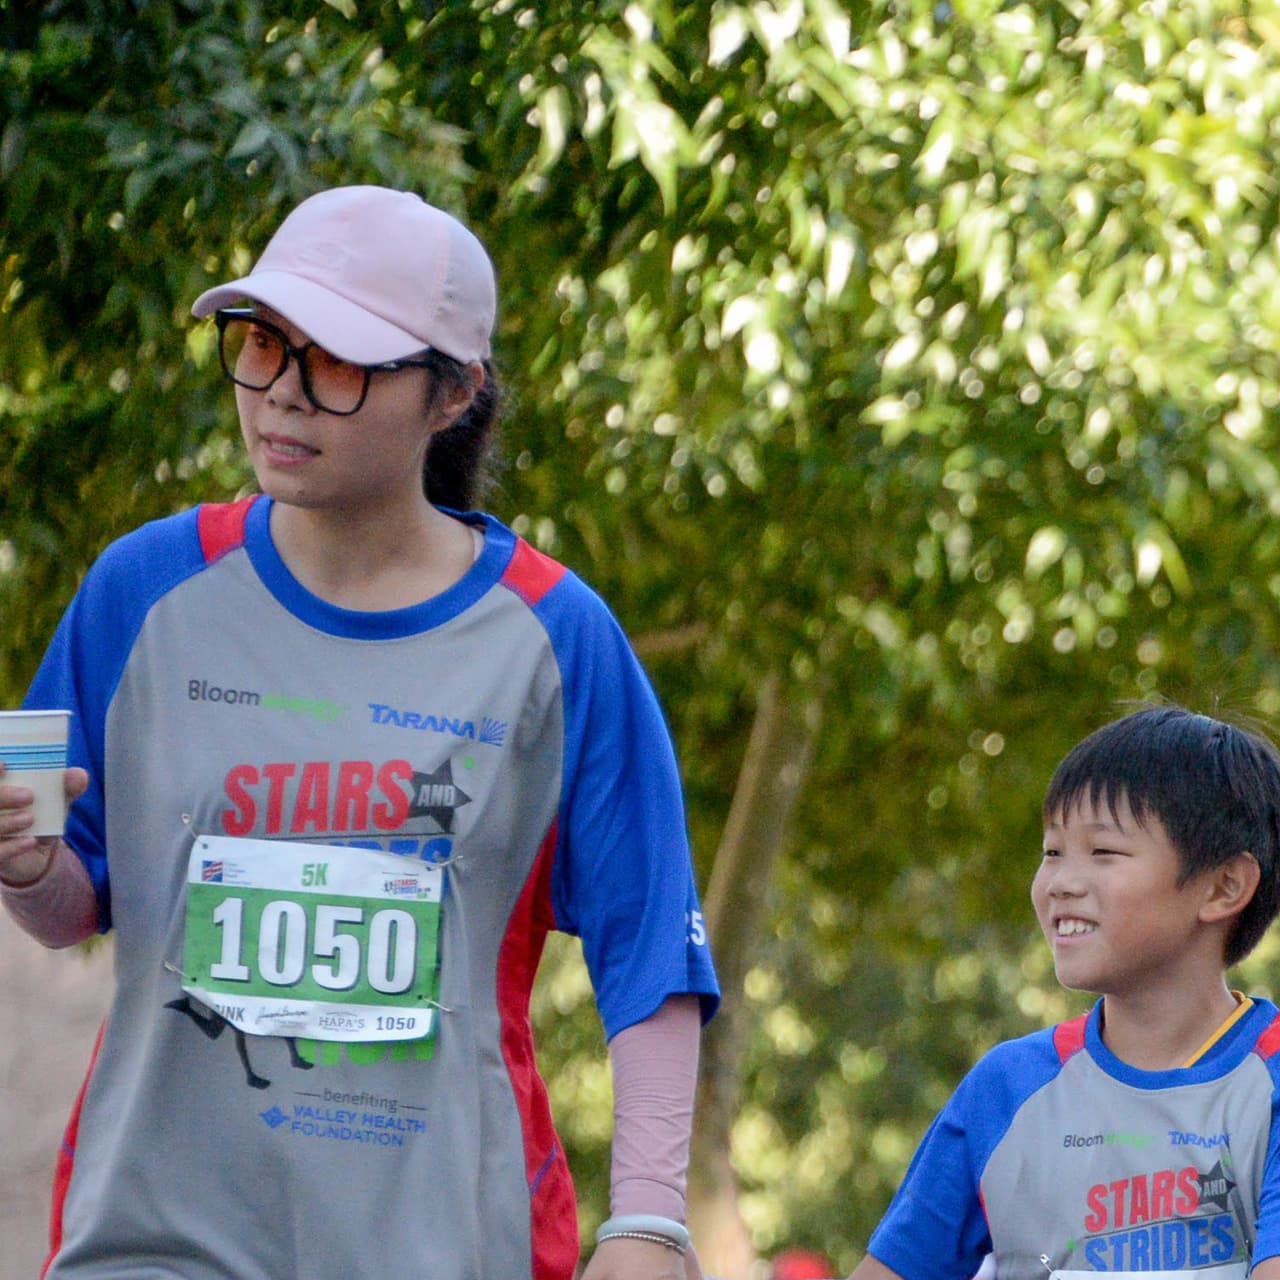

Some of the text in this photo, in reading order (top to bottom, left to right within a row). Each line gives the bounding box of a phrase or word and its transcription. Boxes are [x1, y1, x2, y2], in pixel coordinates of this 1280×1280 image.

[368, 703, 475, 739] TARANA
[221, 760, 414, 836] STARS
[417, 783, 455, 807] AND
[301, 863, 328, 887] 5K
[209, 897, 418, 994] 1050
[376, 1016, 415, 1031] 1050
[324, 1088, 398, 1113] benefiting
[293, 1105, 427, 1134] VALLEY HEALTH
[291, 1122, 404, 1146] FOUNDATION
[1084, 1166, 1200, 1232] STARS
[1203, 1179, 1228, 1199] AND
[1085, 1215, 1236, 1271] STRIDES
